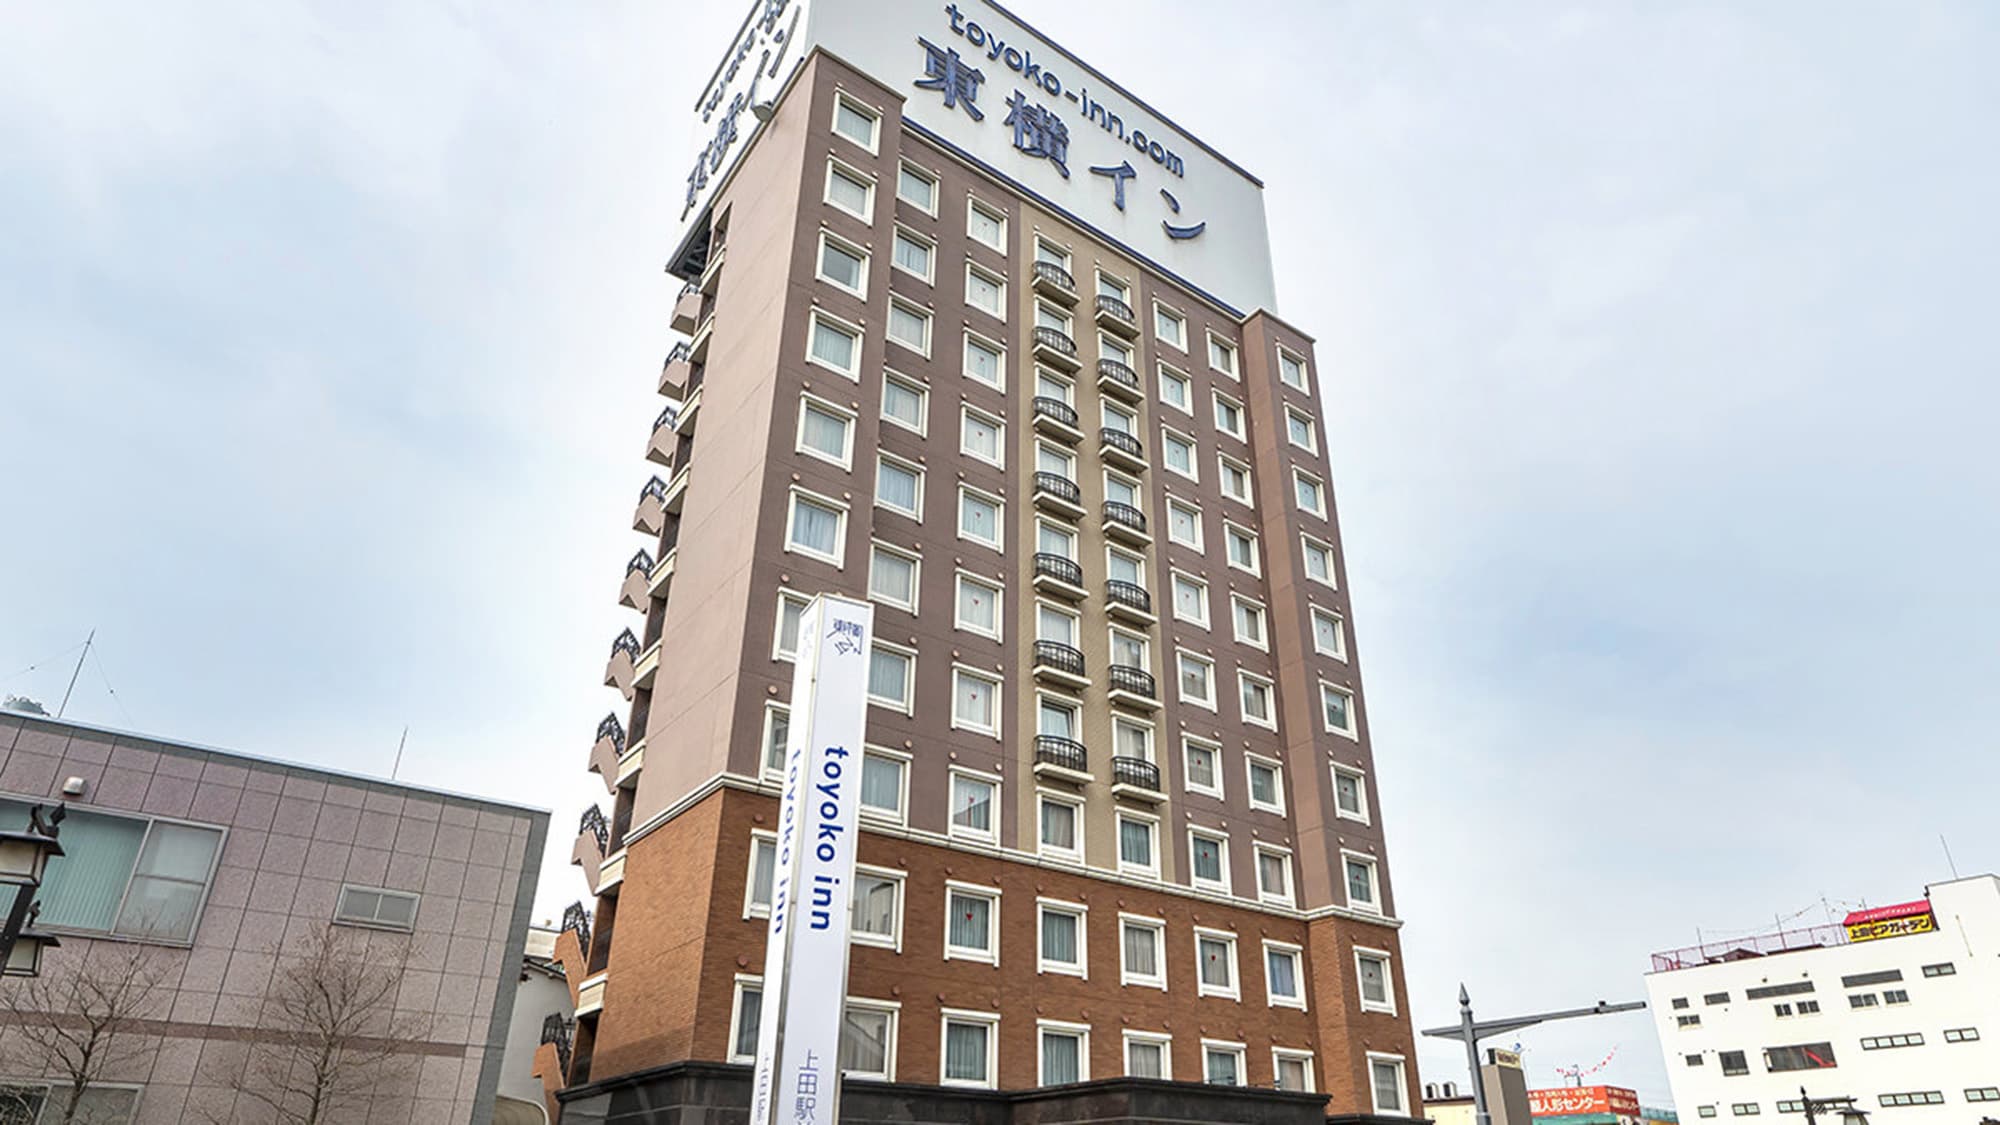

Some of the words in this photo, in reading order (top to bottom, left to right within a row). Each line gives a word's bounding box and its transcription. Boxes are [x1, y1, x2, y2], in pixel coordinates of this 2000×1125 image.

[914, 36, 1206, 240] 東横イン
[945, 3, 1185, 178] toyoko-inn.com
[780, 749, 801, 865] toyoko
[816, 745, 849, 862] toyoko
[774, 878, 791, 933] inn
[810, 875, 840, 930] inn
[794, 1048, 819, 1125] 上田駅
